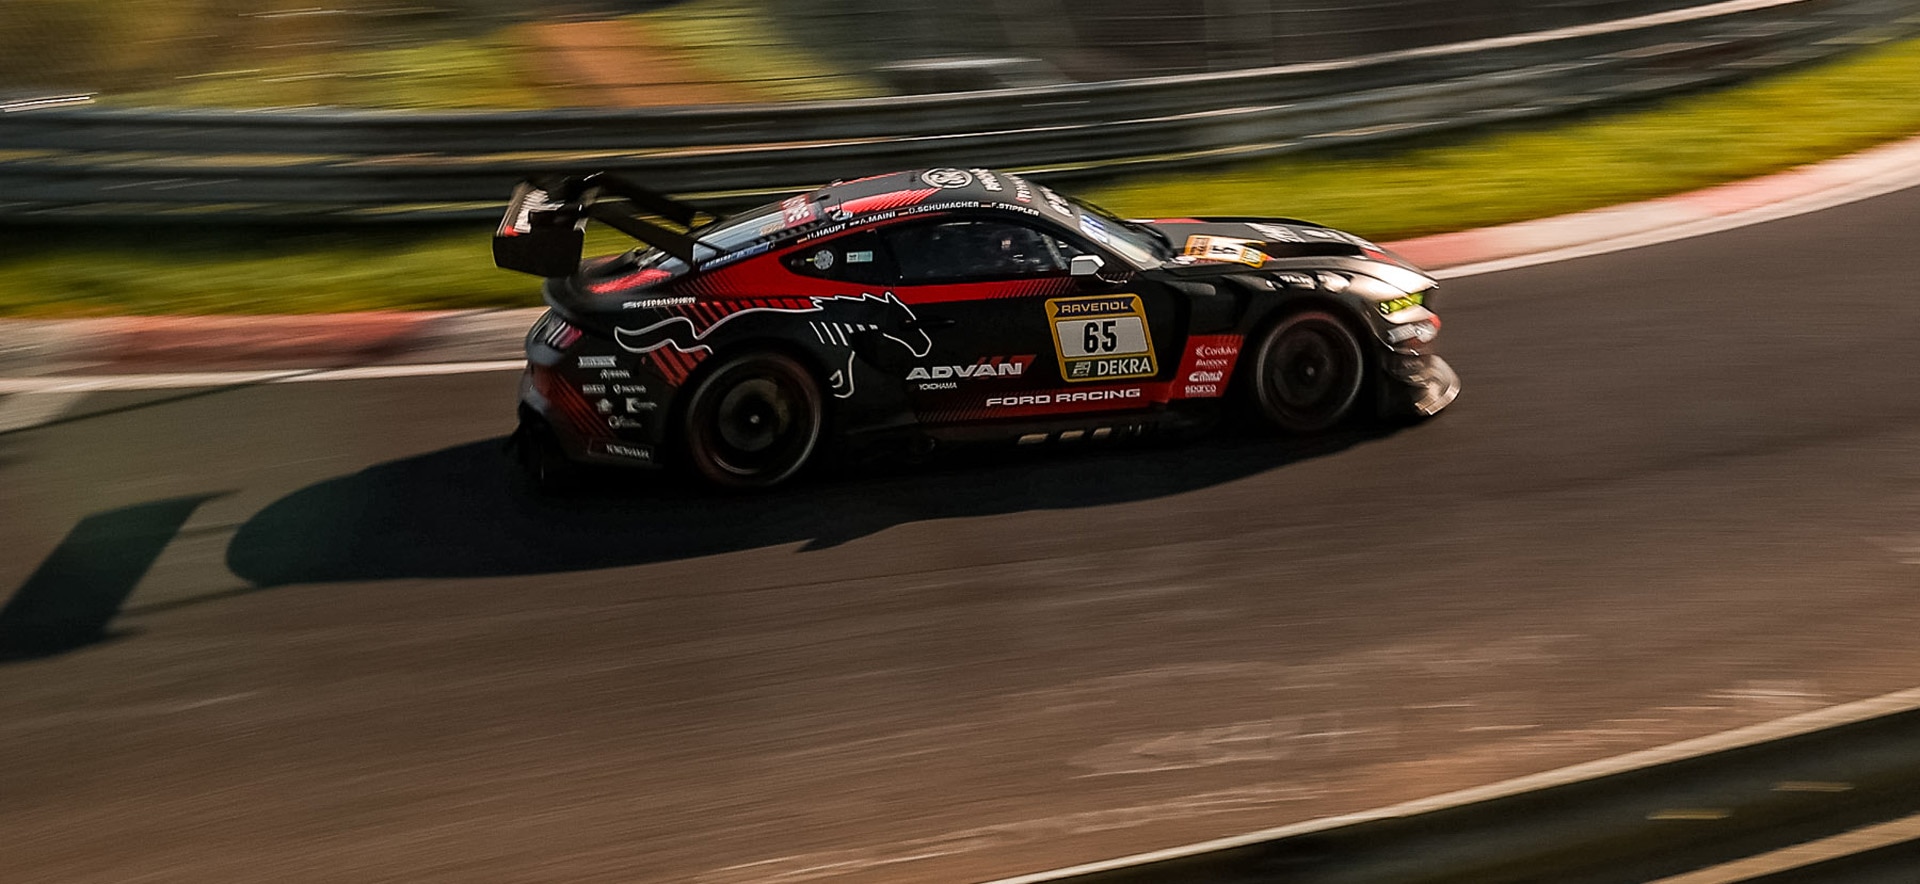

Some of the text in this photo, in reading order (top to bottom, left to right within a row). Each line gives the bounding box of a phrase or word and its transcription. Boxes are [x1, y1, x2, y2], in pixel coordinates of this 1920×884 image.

[860, 211, 896, 225] A.MAINI
[908, 201, 979, 214] D.SCHUMACHER
[991, 202, 1040, 217] F.STIPPLER
[1061, 301, 1128, 313] RAVENOL
[1083, 320, 1117, 353] 65
[905, 362, 1022, 380] ADVAN
[1097, 357, 1151, 376] DEKRA
[918, 382, 957, 390] YOKOHAMA
[986, 388, 1141, 407] FORD RACING
